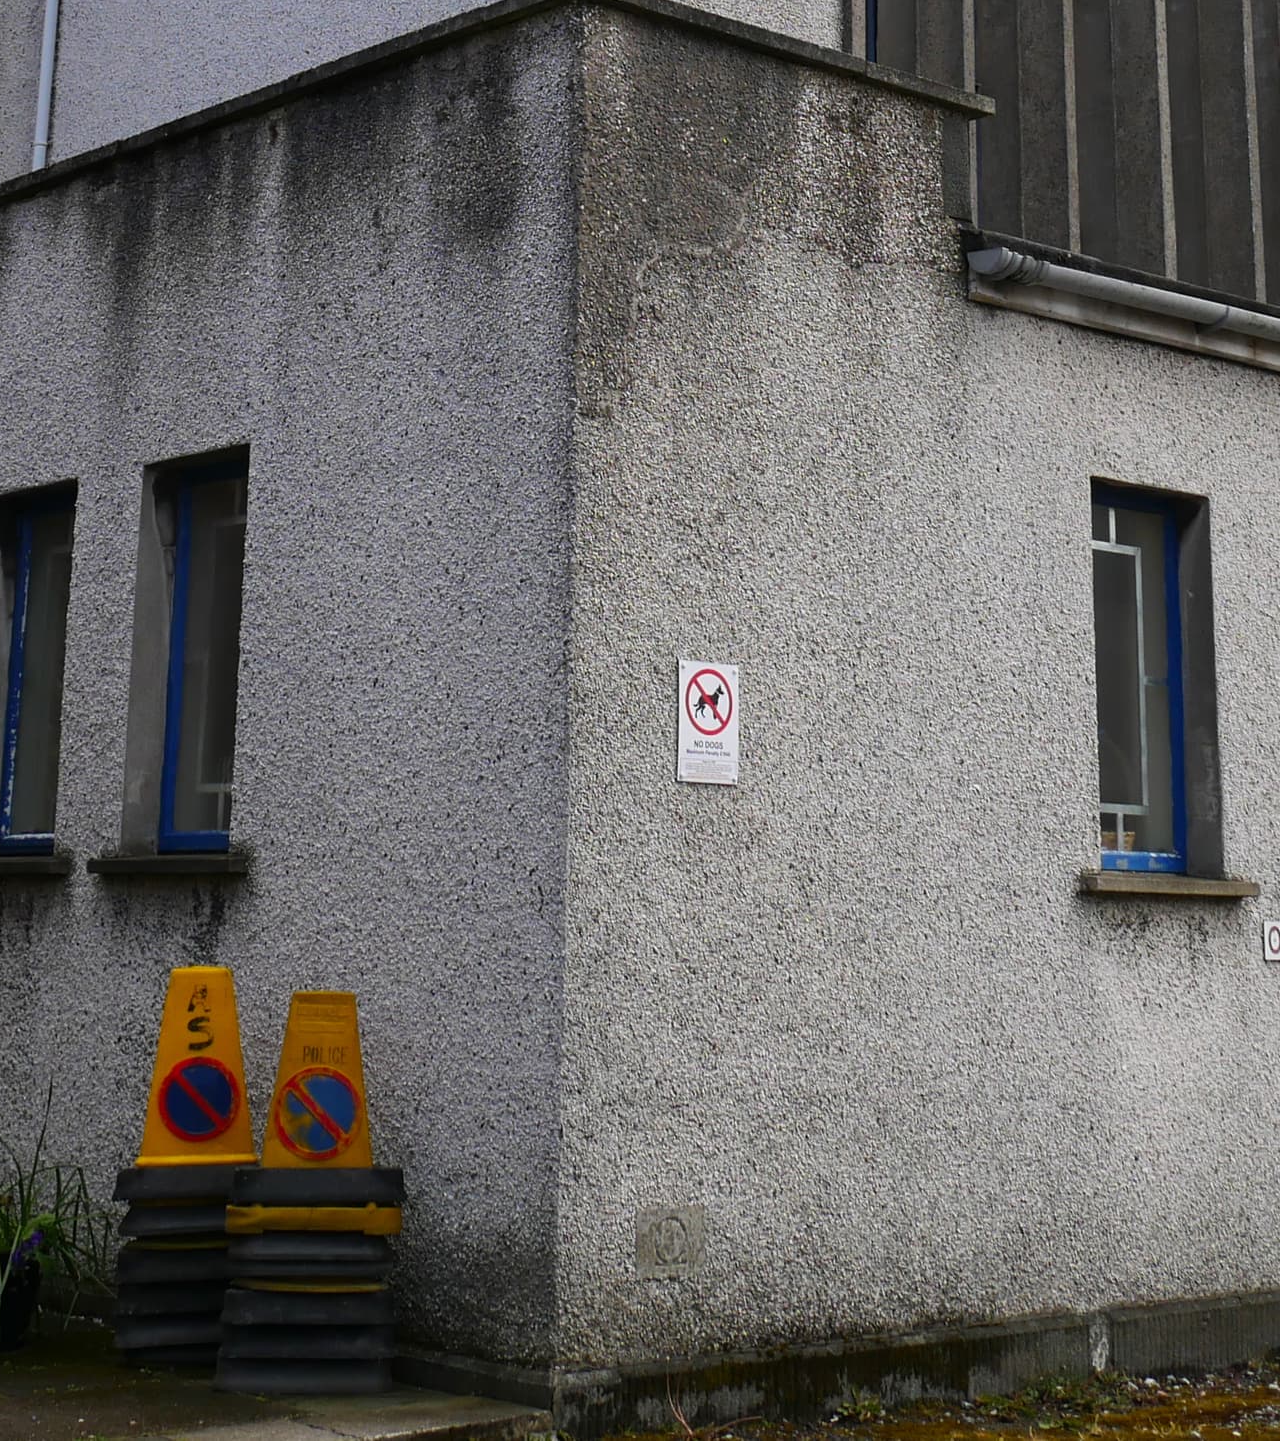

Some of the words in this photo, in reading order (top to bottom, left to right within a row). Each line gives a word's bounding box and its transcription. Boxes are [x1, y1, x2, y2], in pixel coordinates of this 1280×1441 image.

[694, 740, 704, 748] NO
[705, 741, 724, 749] DOGS
[302, 1045, 349, 1065] POLICE
